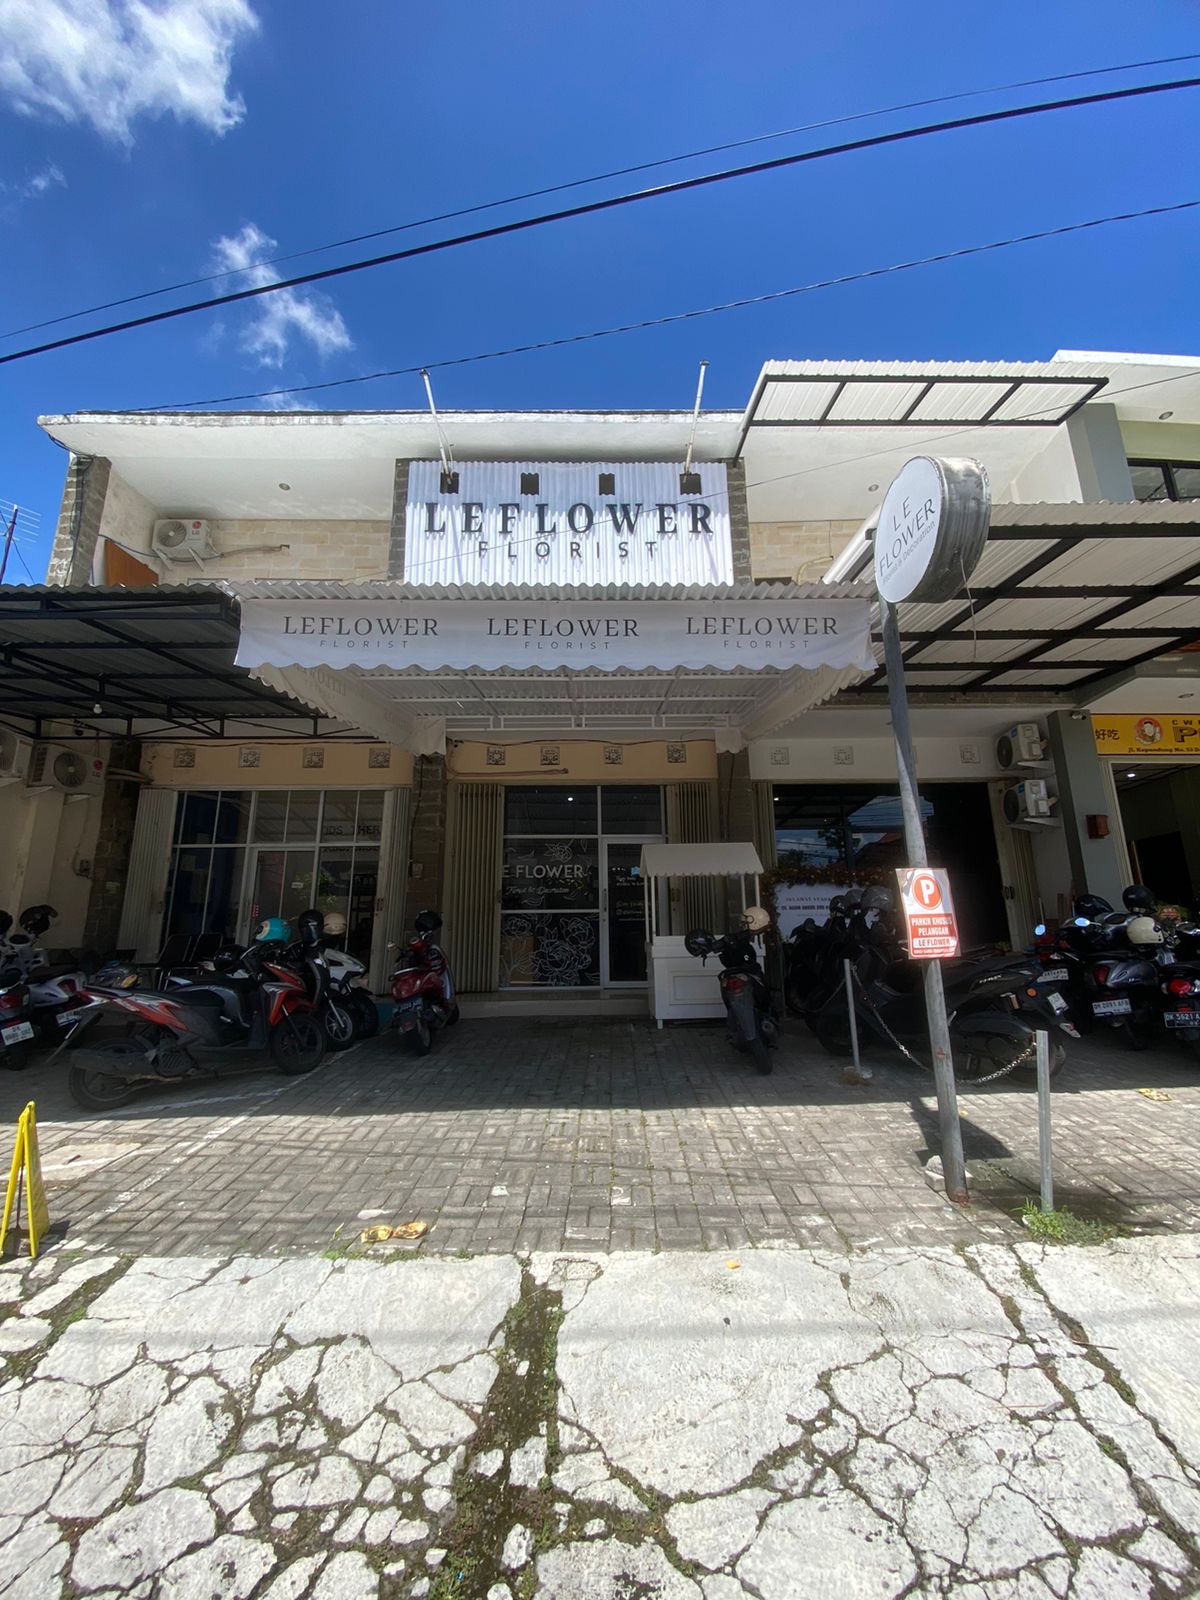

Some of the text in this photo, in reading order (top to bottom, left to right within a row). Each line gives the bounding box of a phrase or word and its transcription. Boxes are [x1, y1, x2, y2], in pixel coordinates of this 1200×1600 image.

[425, 502, 713, 535] LEFLOWER
[893, 496, 911, 532] LE
[879, 498, 936, 577] FLOWER
[479, 541, 657, 558] FLORIST
[283, 616, 438, 636] LEFLOWER
[487, 617, 639, 637] LEFLOWER
[686, 617, 838, 636] LEFLOWER
[320, 640, 408, 648] FLORIST
[525, 641, 610, 649] FLORIST
[723, 640, 809, 649] FLORIST
[1095, 728, 1120, 740] 好吃
[516, 864, 583, 878] FLOWER
[920, 879, 935, 905] P
[912, 918, 932, 926] PARKIR
[918, 927, 949, 936] PELANGGAN
[918, 938, 951, 947] LE FLOWER
